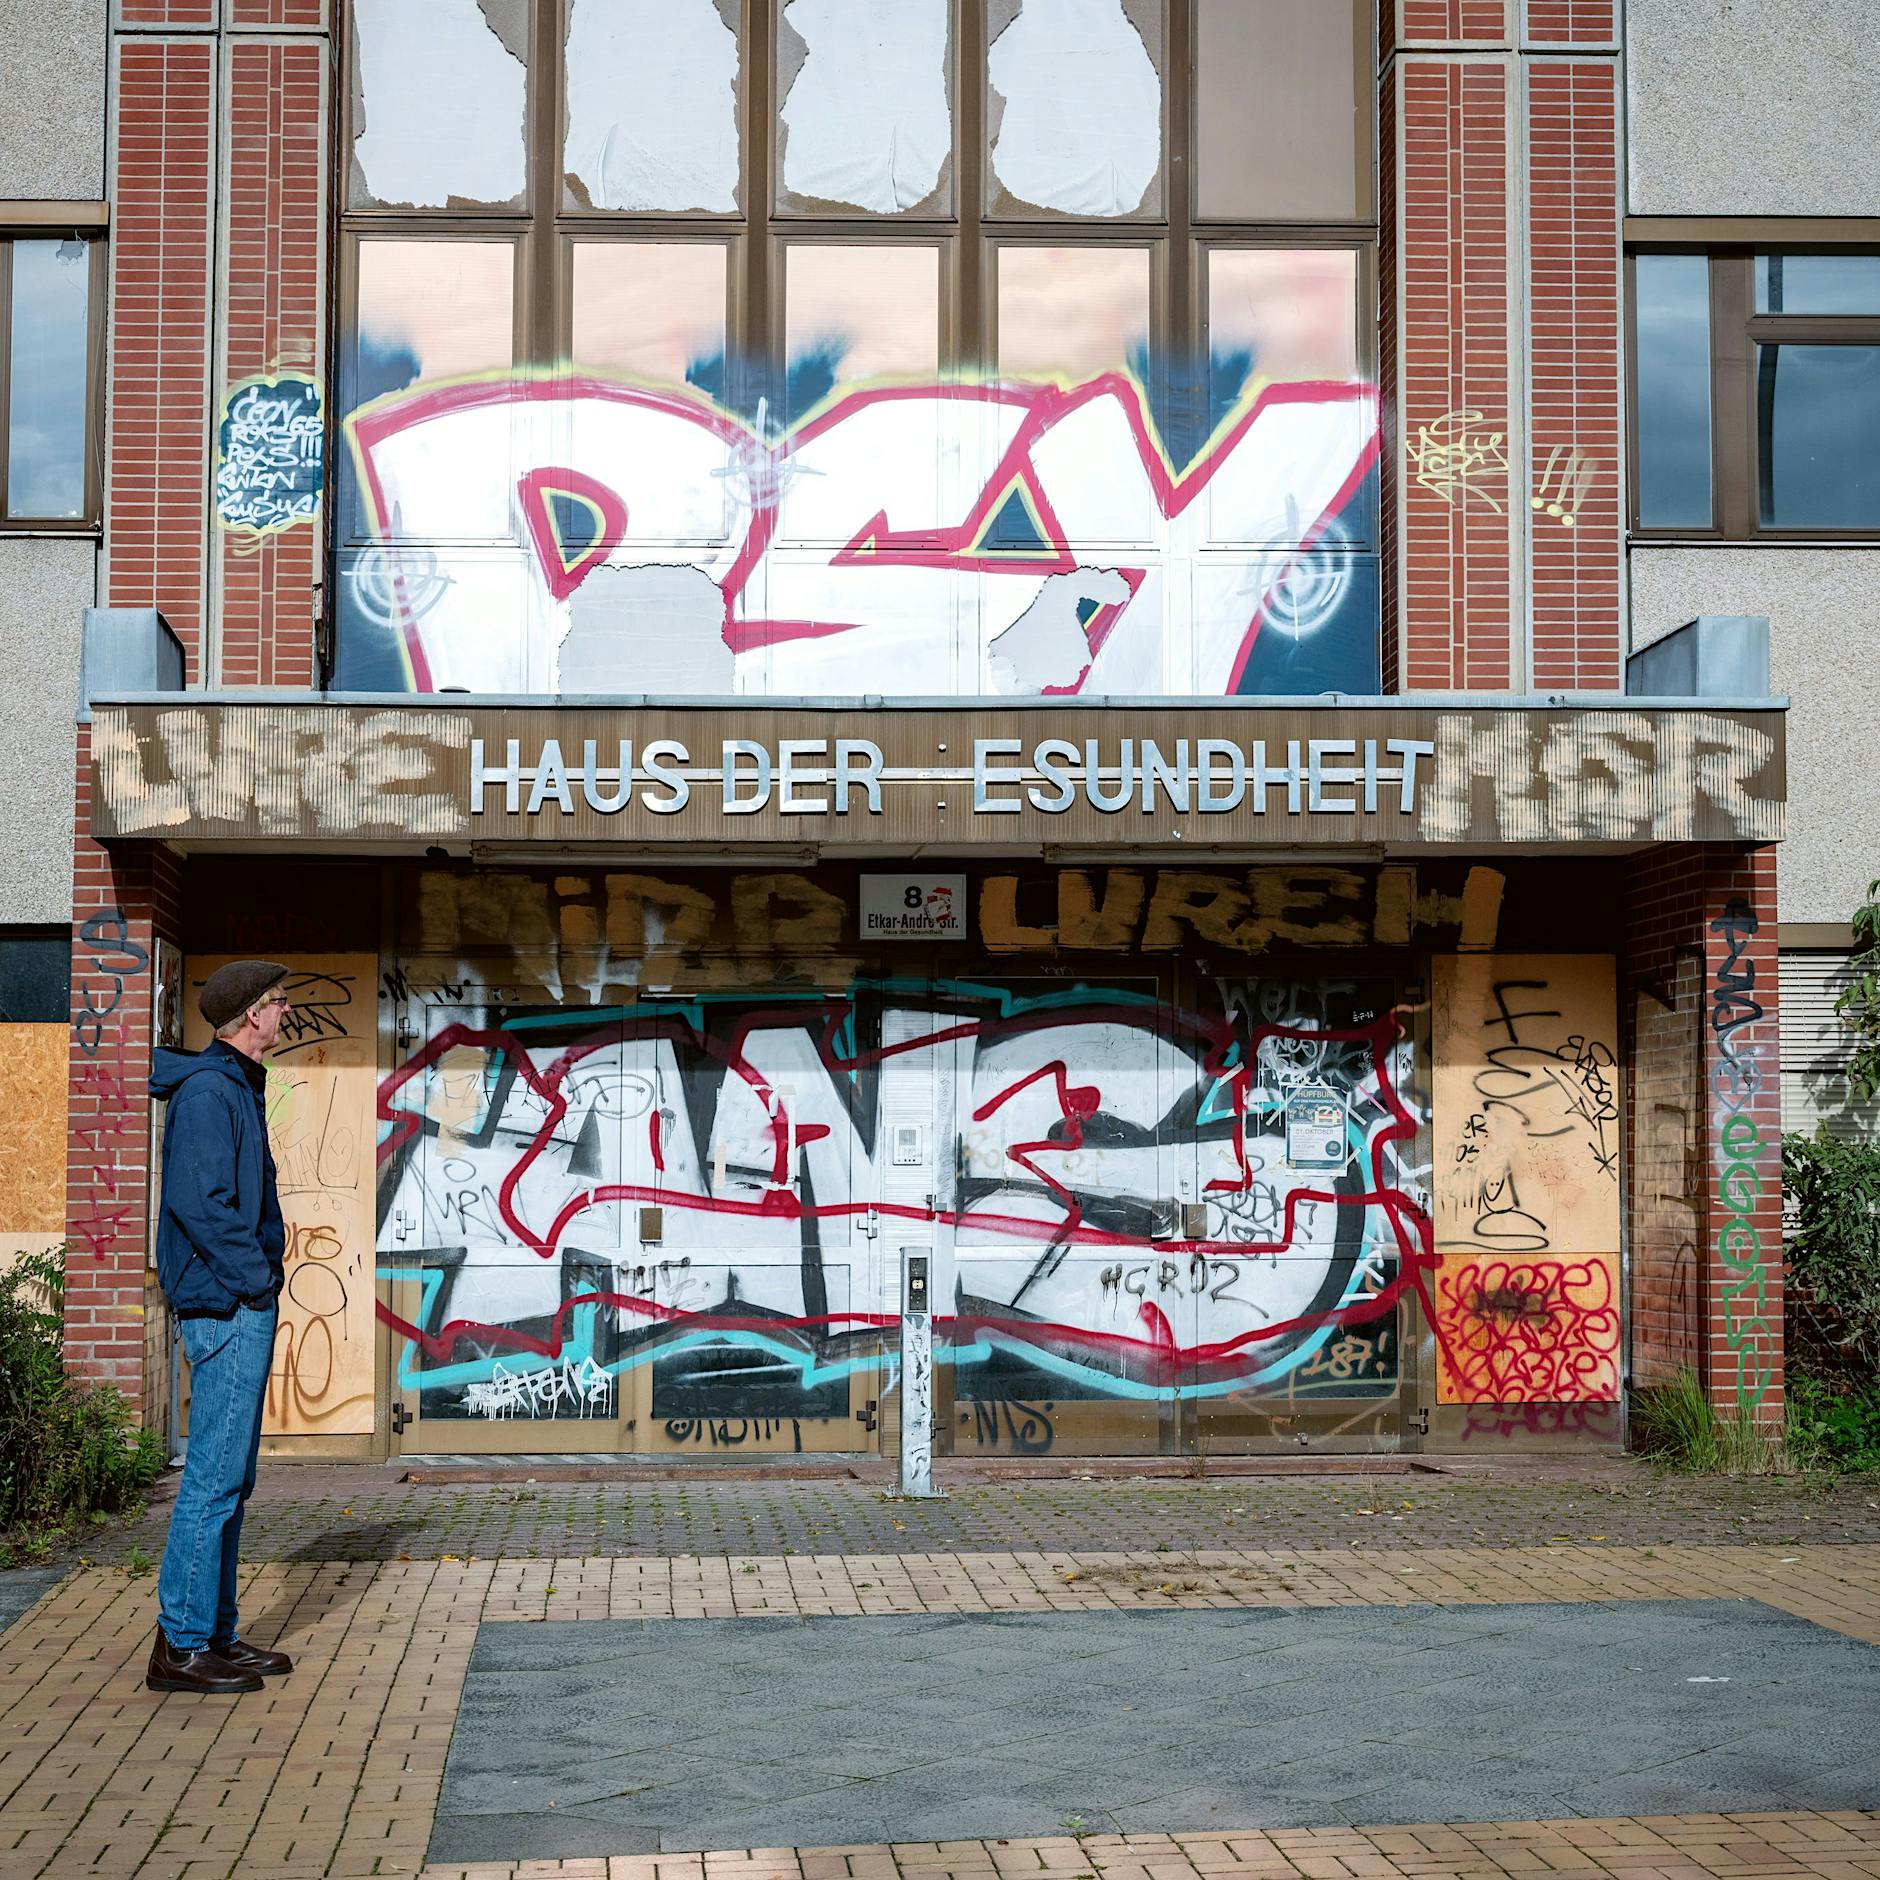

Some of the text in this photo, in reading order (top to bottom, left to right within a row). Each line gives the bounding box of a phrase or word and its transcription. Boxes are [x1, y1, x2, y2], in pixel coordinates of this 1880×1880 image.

[470, 738, 1435, 814] HAUS DER ESUNDHEIT
[904, 886, 923, 908] 8
